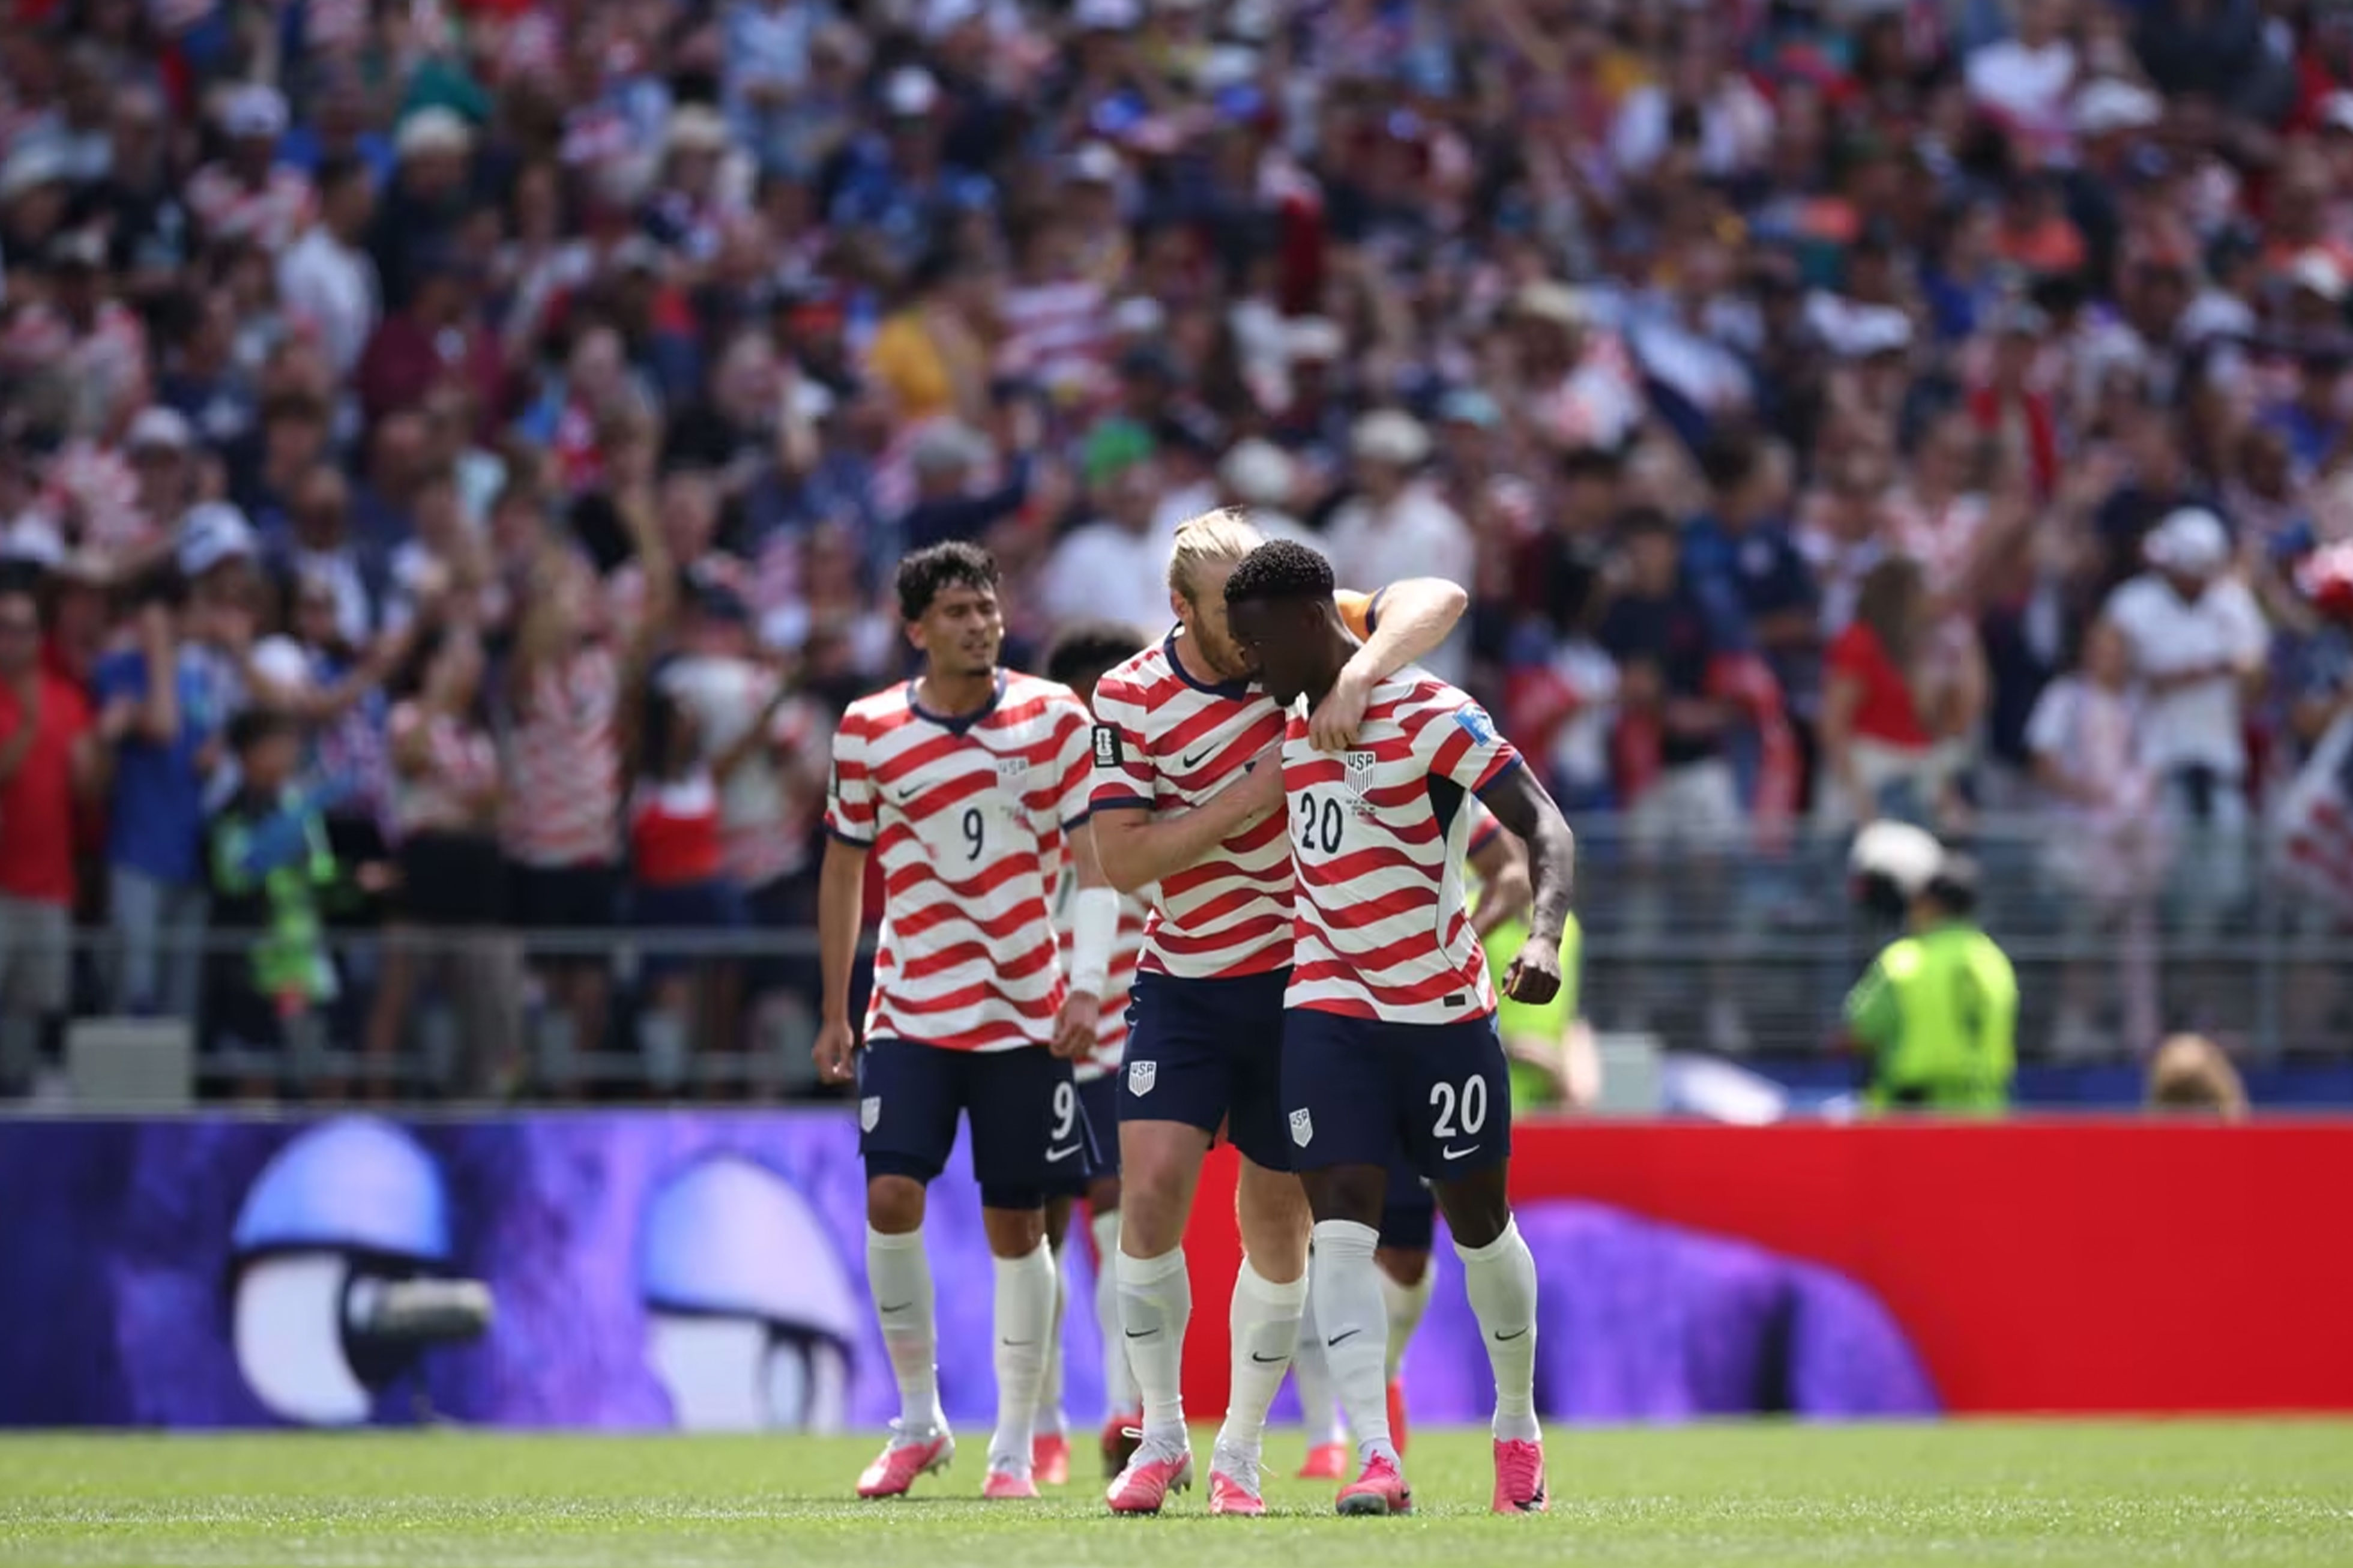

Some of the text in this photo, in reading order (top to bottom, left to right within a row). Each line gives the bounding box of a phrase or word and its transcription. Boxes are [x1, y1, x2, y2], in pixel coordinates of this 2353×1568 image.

[1348, 753, 1374, 771] USA
[963, 807, 984, 861] 9
[1300, 792, 1343, 854] 20
[1052, 1081, 1075, 1140] 9
[1430, 1074, 1487, 1138] 20
